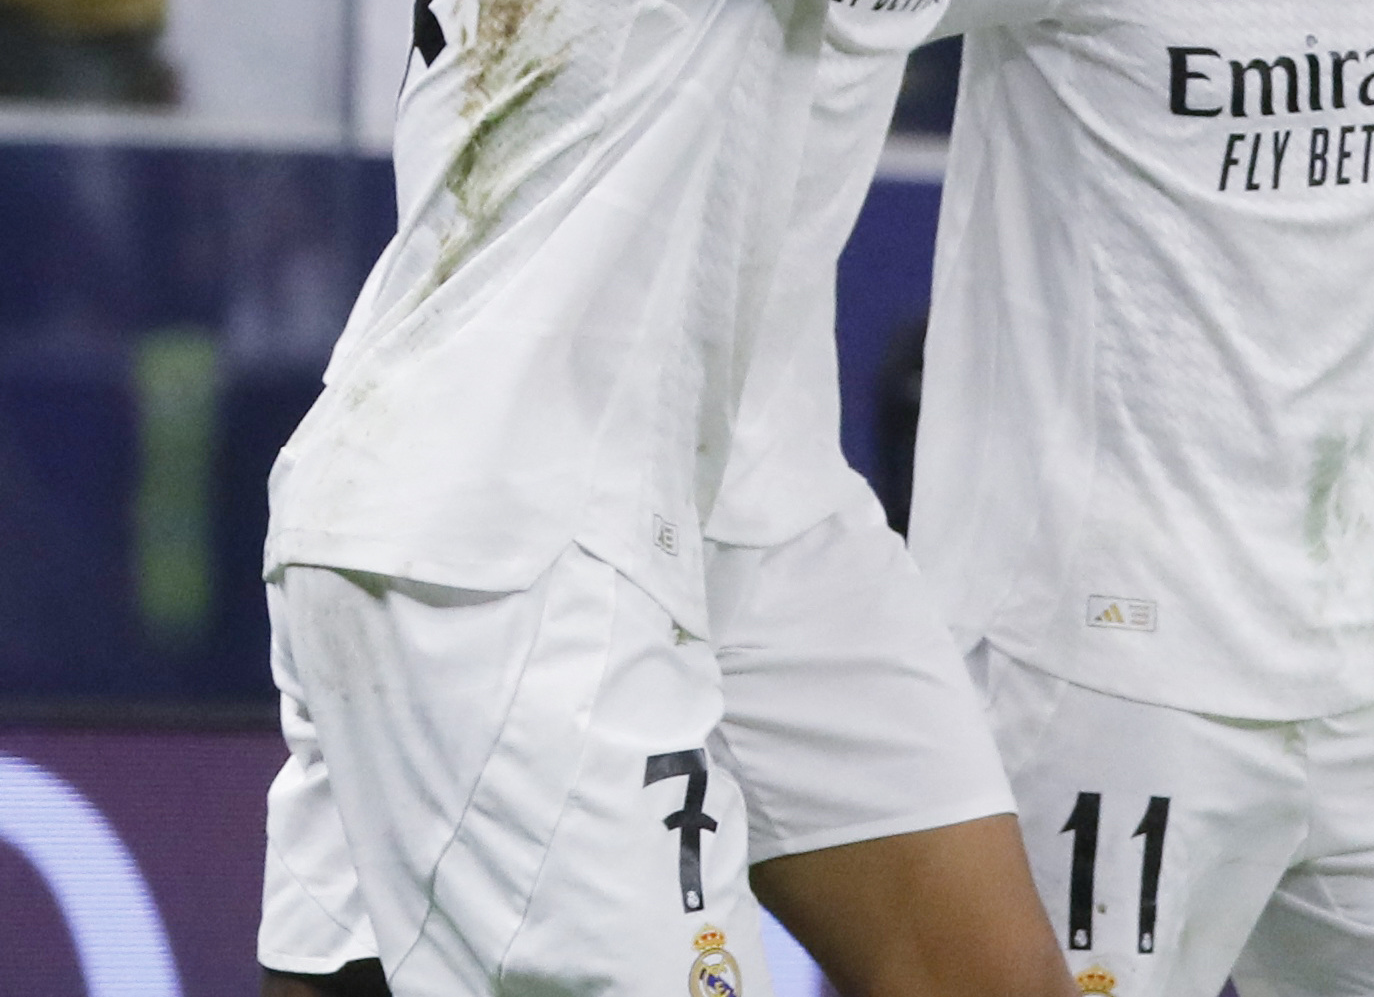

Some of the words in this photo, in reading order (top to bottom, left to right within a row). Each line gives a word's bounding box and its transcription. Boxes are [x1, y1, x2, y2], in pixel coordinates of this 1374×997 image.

[1218, 128, 1291, 192] FLY
[642, 748, 718, 913] 7
[1059, 791, 1171, 954] 11
